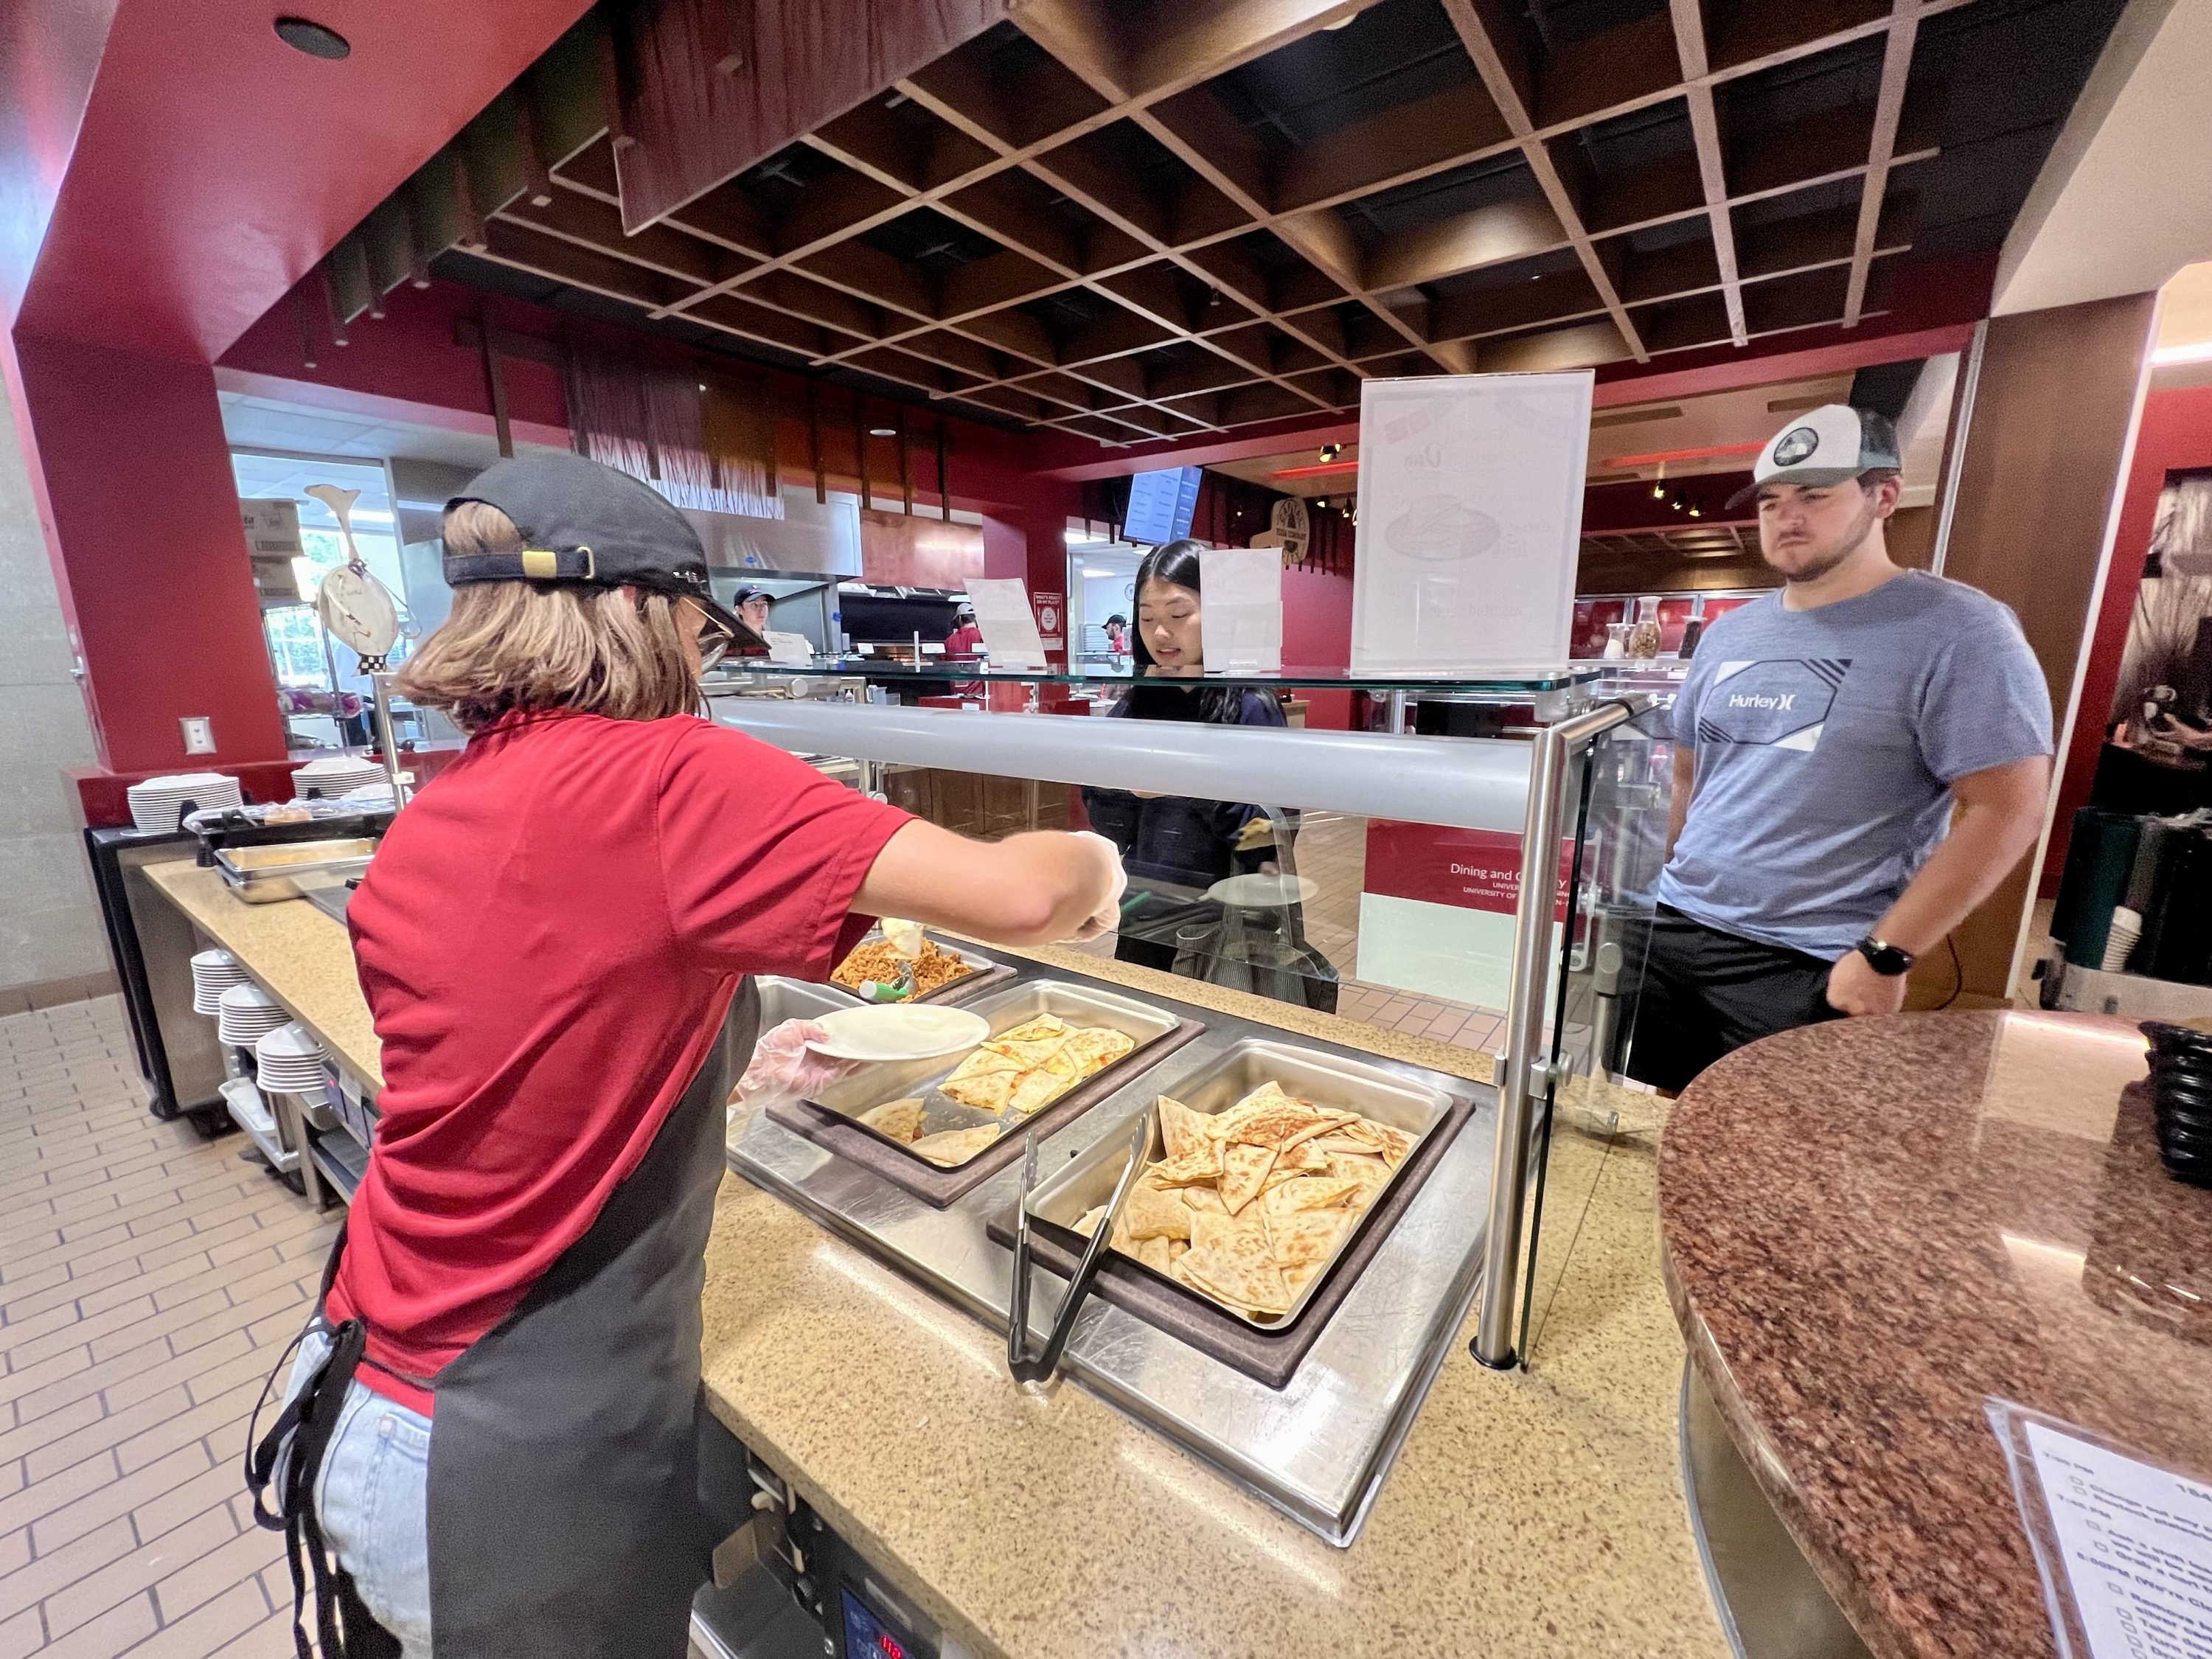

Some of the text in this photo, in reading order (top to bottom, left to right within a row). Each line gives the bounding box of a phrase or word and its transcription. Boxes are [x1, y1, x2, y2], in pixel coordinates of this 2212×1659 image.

[1728, 694, 1779, 710] Hurley
[1450, 863, 1488, 880] Dining
[1489, 869, 1512, 881] and
[1463, 886, 1505, 898] UNIVERSITY
